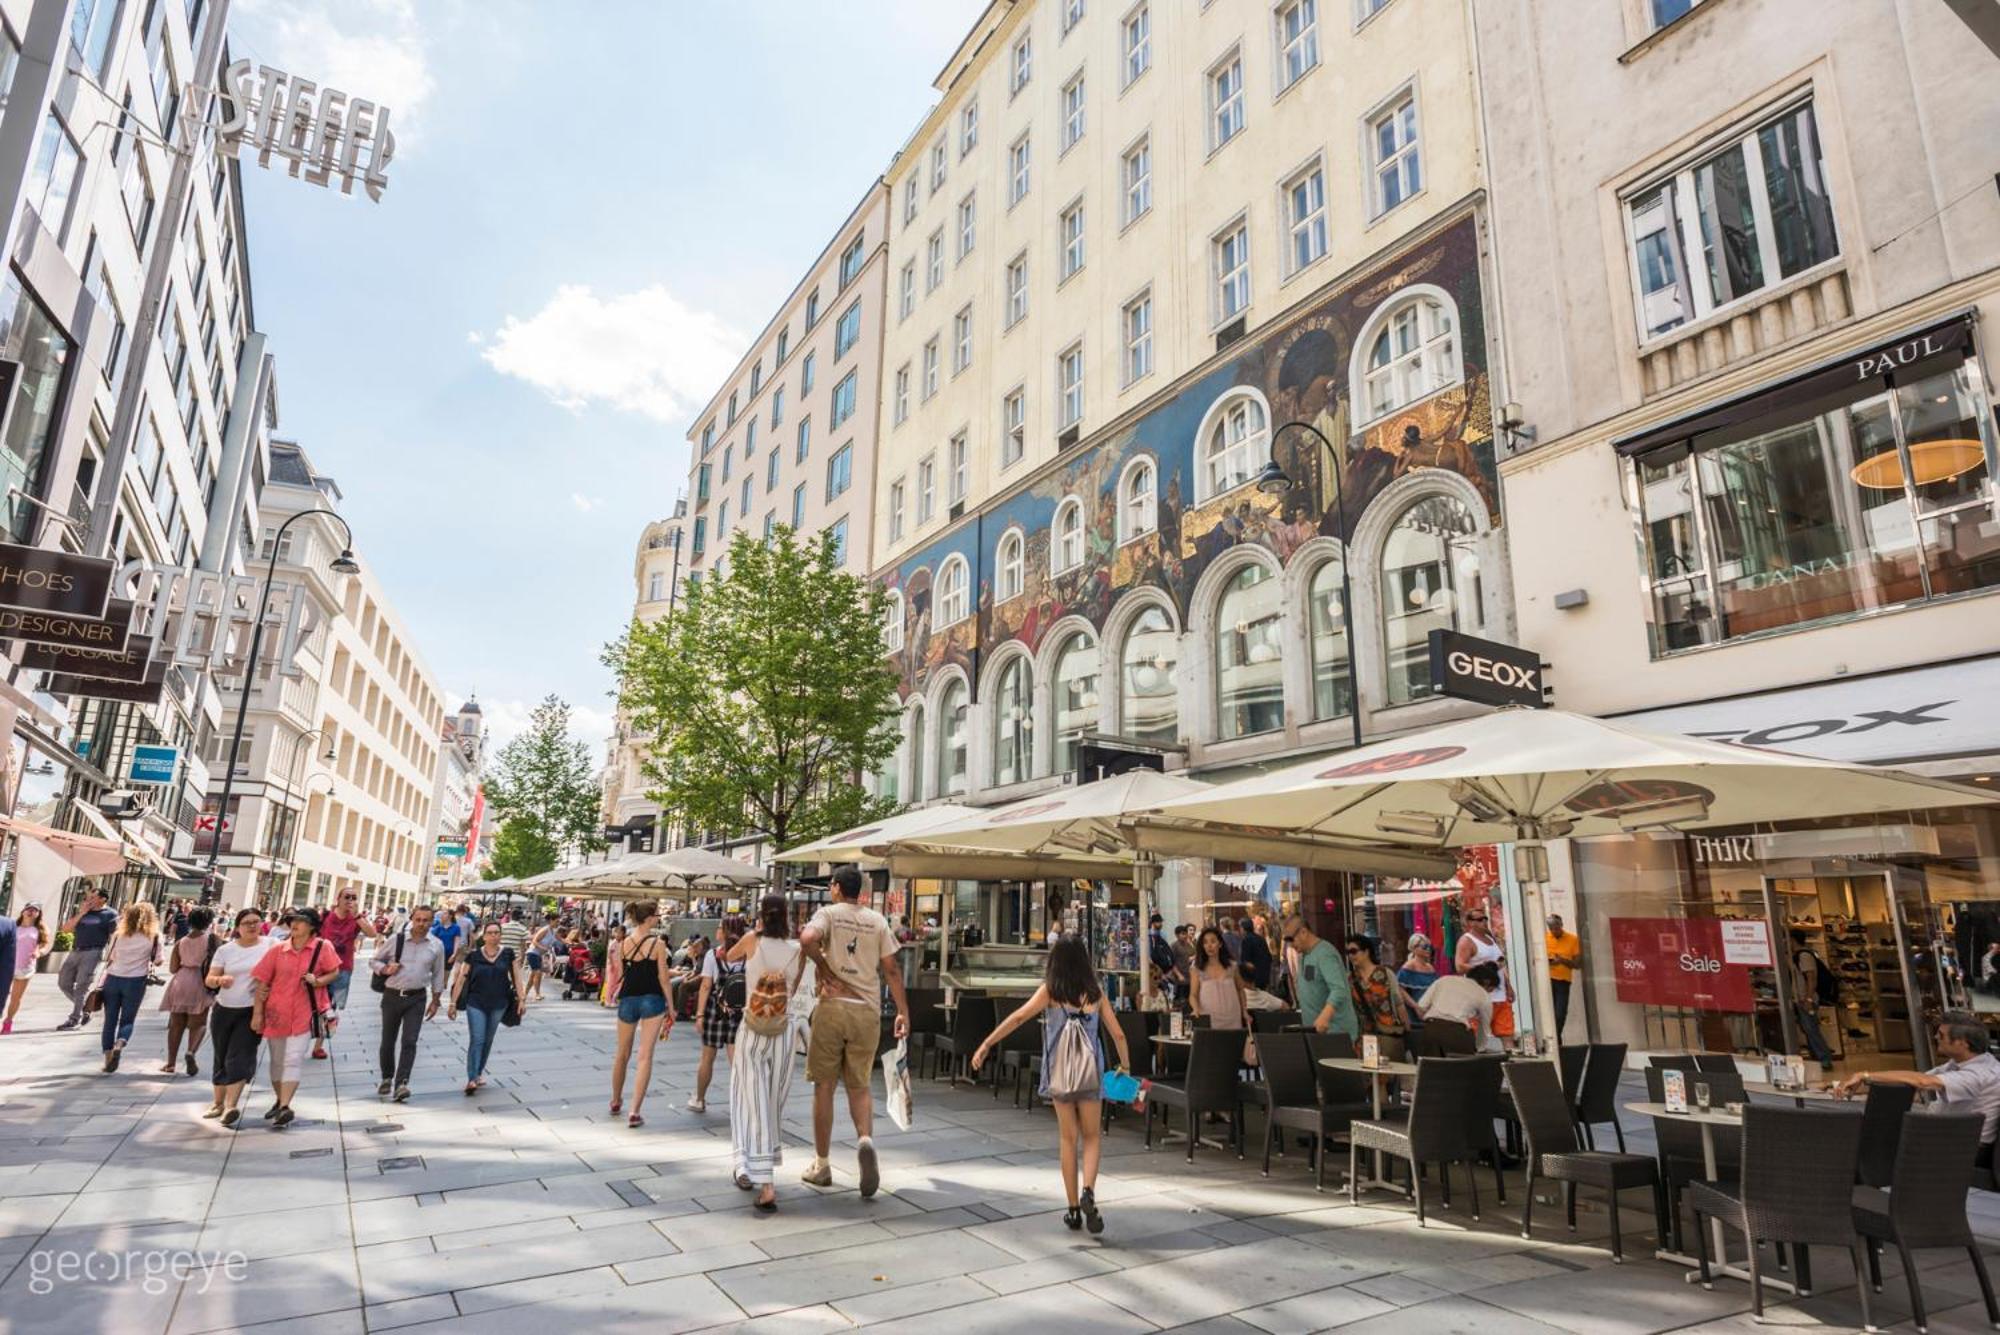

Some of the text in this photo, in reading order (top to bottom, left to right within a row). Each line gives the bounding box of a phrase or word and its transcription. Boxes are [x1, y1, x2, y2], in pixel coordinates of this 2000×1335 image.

[220, 58, 390, 189] STEFFL
[1856, 336, 1943, 380] PAUL
[0, 566, 74, 592] HOES
[1, 612, 113, 641] DESIGNER
[1448, 651, 1537, 691] GEOX
[1680, 953, 1721, 973] Sale
